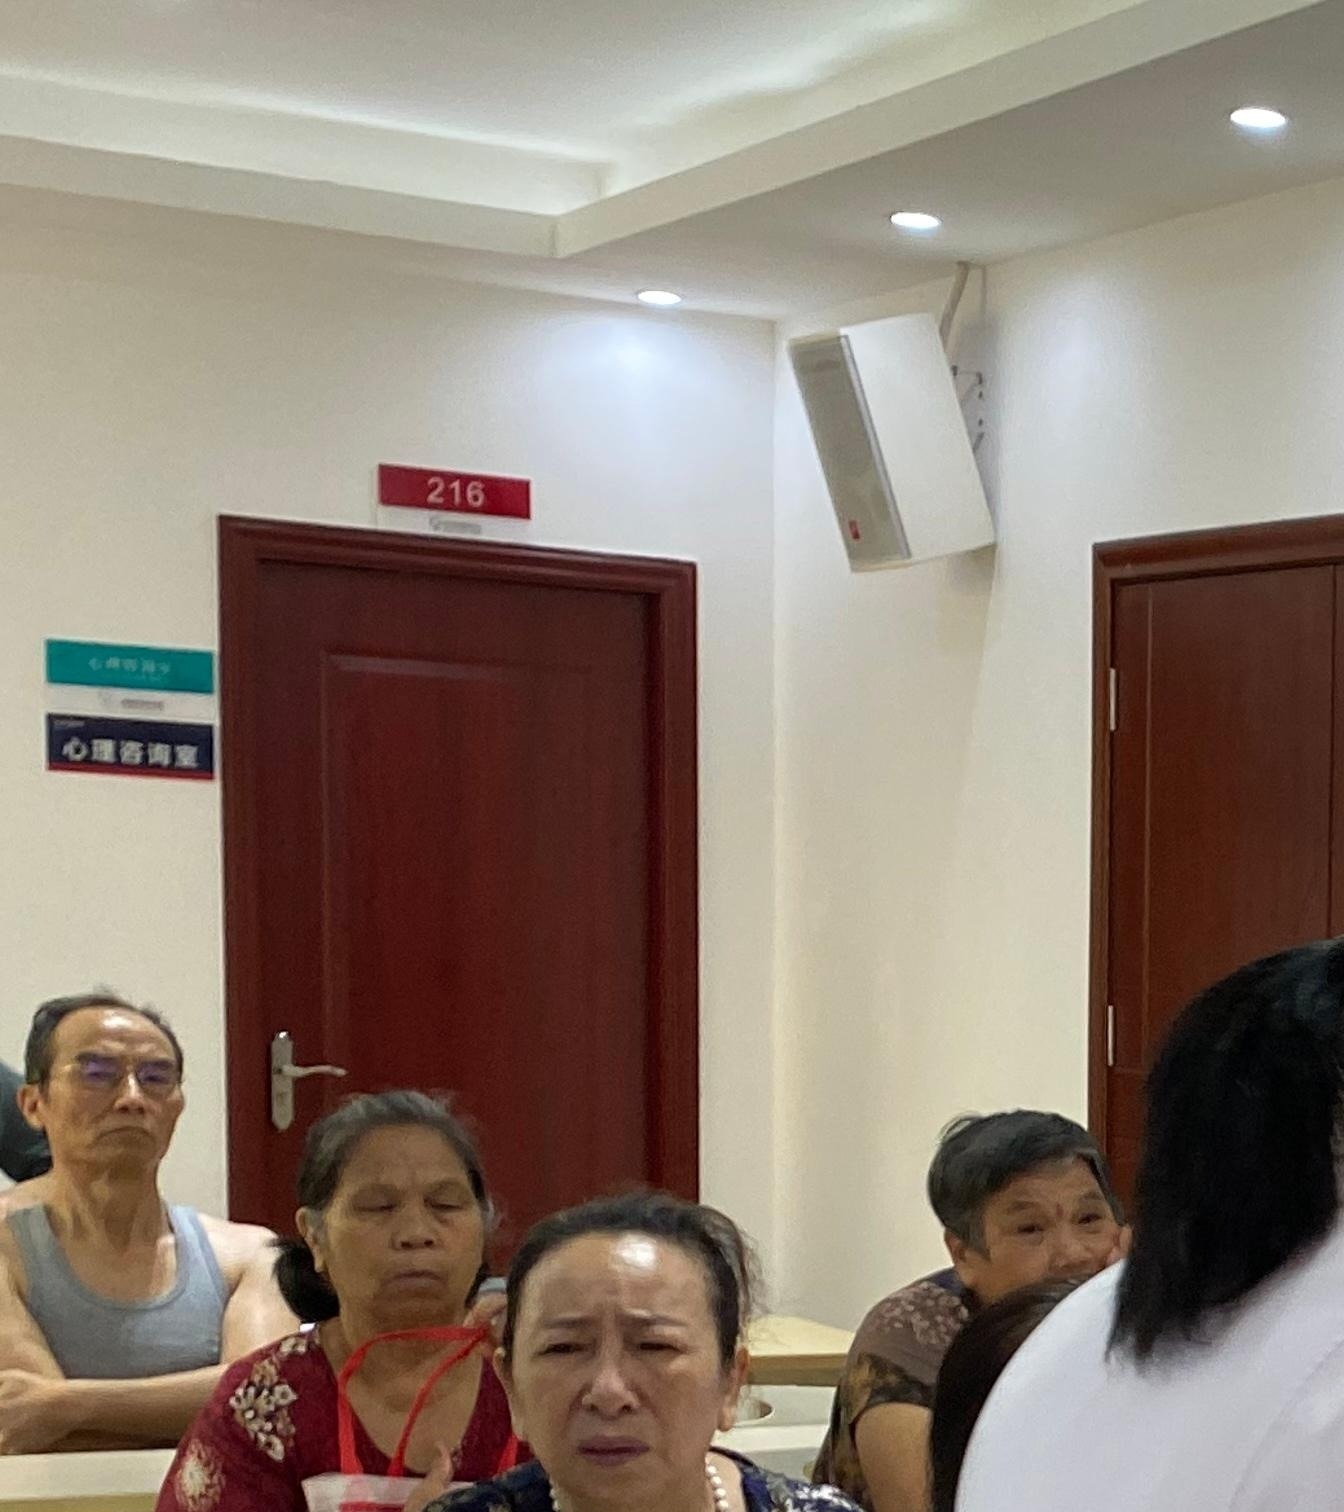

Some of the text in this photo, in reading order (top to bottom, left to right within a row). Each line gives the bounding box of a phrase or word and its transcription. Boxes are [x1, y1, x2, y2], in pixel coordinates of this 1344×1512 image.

[427, 476, 485, 508] 216
[62, 737, 199, 768] 心理咨询室
